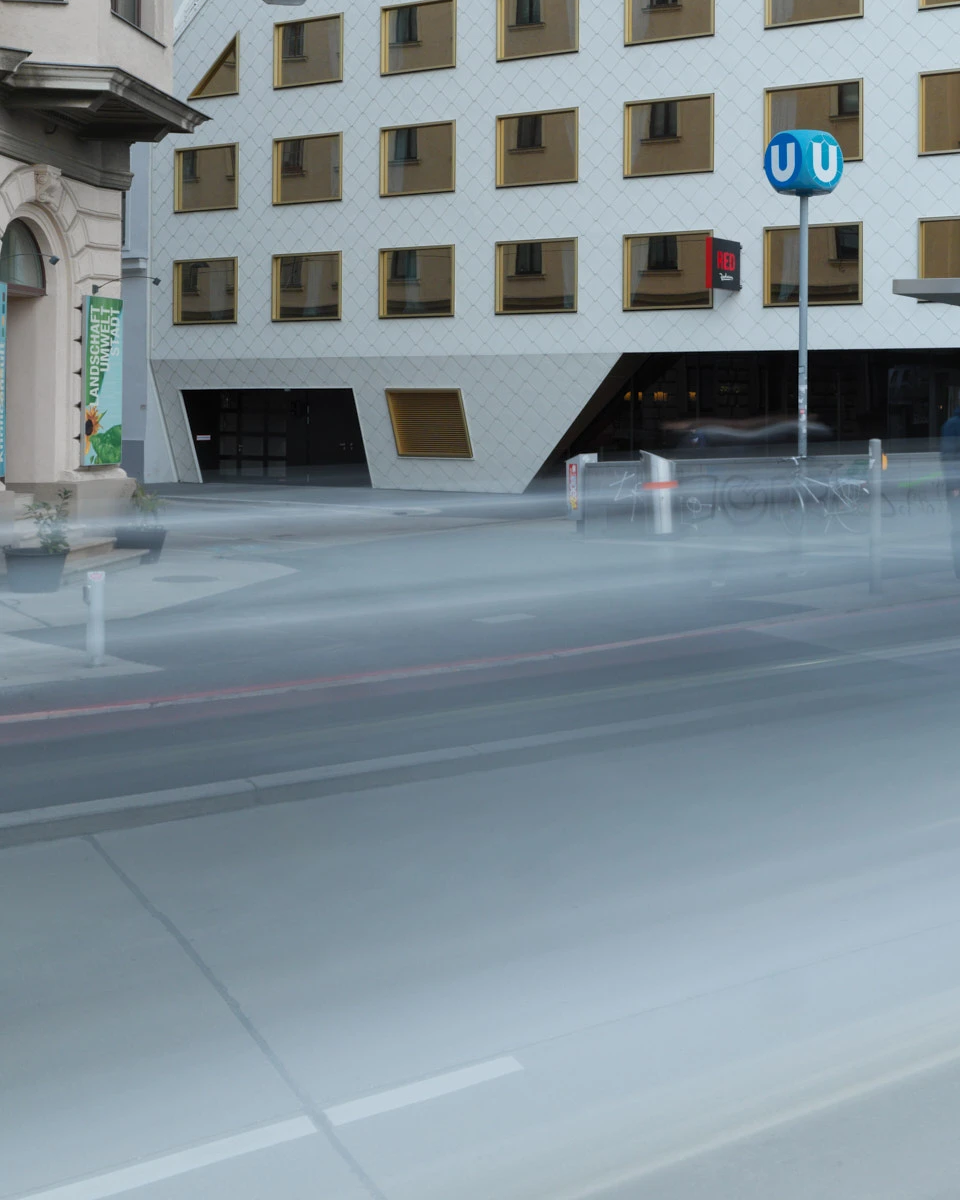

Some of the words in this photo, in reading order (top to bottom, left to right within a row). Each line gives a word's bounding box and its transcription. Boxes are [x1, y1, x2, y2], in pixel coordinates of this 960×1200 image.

[770, 142, 796, 183] U
[812, 141, 838, 183] U
[716, 250, 737, 272] RED
[99, 305, 112, 373] UMWELT
[110, 306, 121, 357] STADT
[89, 304, 101, 407] LANDSCHAFT
